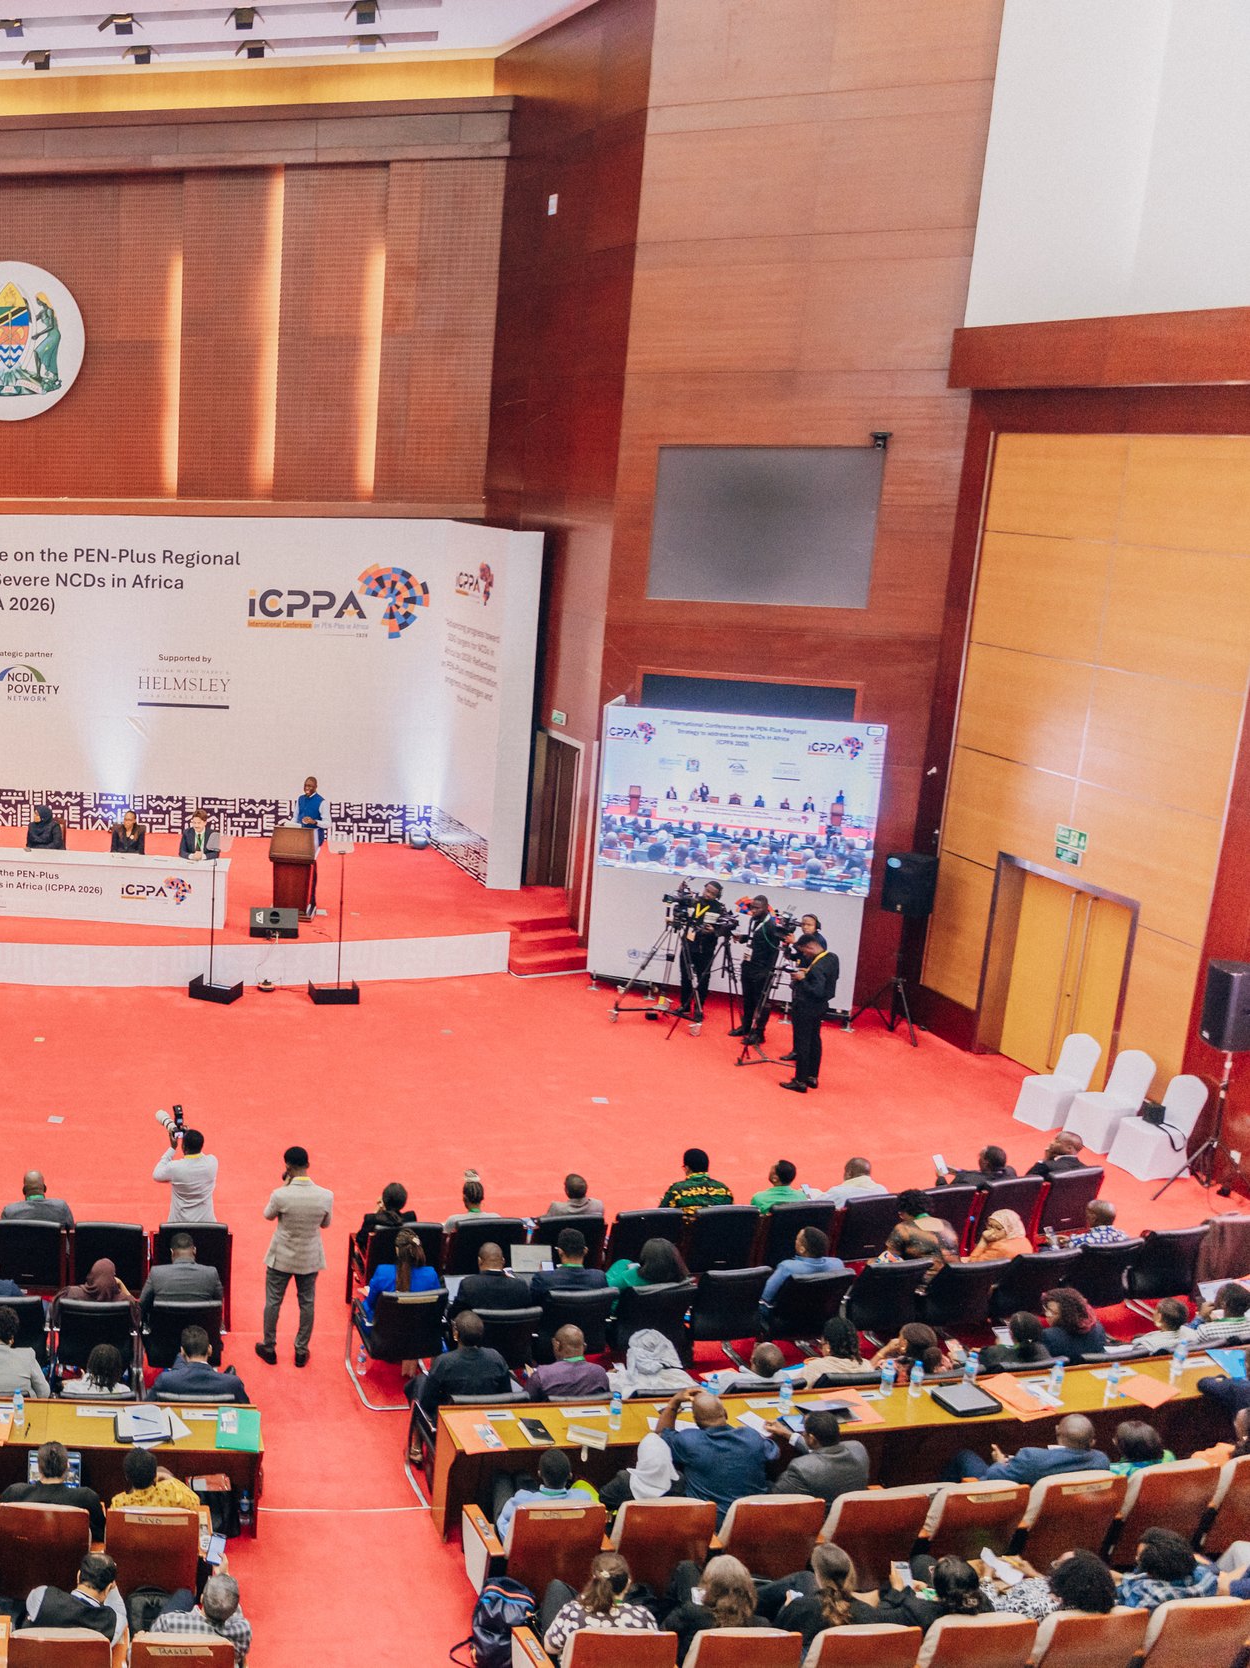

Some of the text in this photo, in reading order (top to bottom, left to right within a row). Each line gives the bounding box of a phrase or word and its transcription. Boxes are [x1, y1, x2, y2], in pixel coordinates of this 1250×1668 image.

[13, 550, 34, 562] on
[40, 548, 68, 562] the
[74, 548, 156, 563] PEN-Plus
[162, 550, 240, 568] Regional
[55, 573, 106, 588] NCDs
[111, 573, 127, 588] in
[132, 574, 184, 589] Africa
[9, 596, 55, 615] 2026)
[248, 588, 367, 619] iCPPA
[24, 651, 53, 659] partner
[158, 653, 212, 664] Supported by
[7, 672, 33, 683] NCDI
[138, 675, 230, 693] HELMSLEY
[7, 684, 60, 695] POVERTY
[0, 869, 14, 877] the
[16, 870, 59, 880] PEN-Plus
[5, 880, 14, 888] in
[16, 880, 43, 890] Africa
[45, 882, 75, 893] (ICPPA
[78, 885, 103, 895] 2026)
[121, 883, 167, 897] iCPPA
